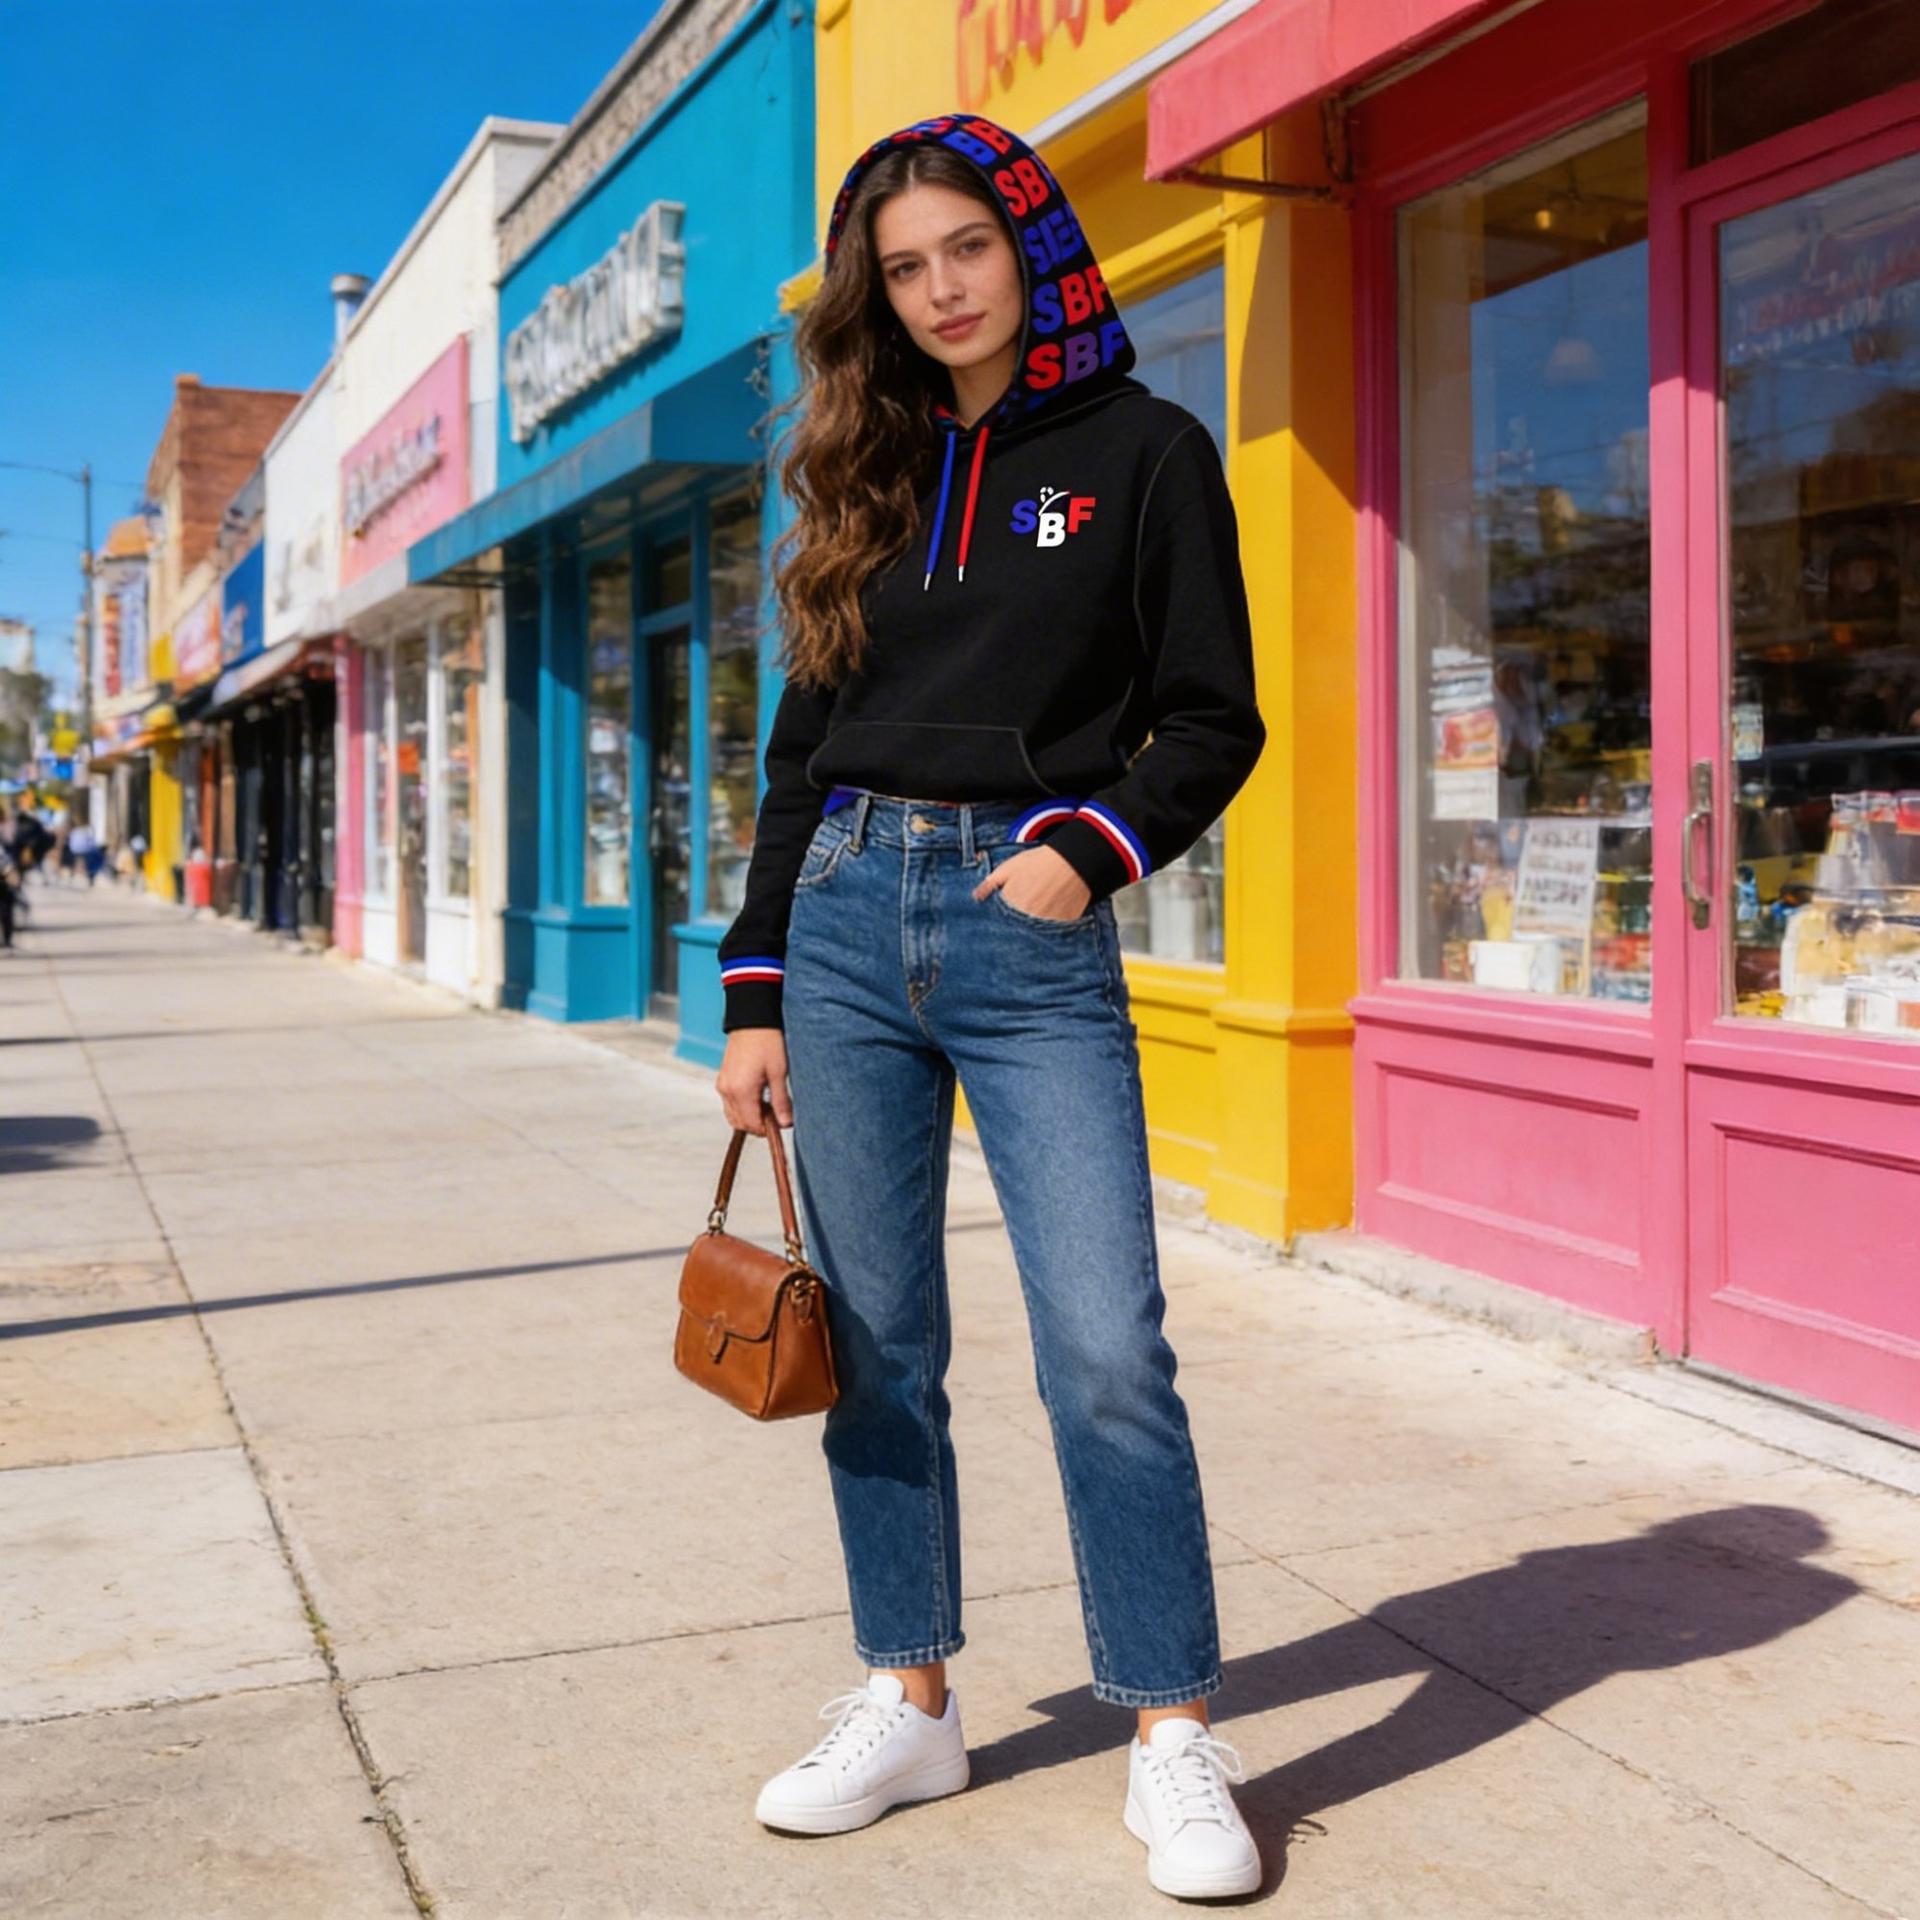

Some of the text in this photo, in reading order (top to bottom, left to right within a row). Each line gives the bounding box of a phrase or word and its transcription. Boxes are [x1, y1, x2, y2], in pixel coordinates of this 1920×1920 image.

[994, 155, 1057, 218] SB
[1024, 319, 1126, 390] SBF
[1009, 497, 1096, 548] SBF
